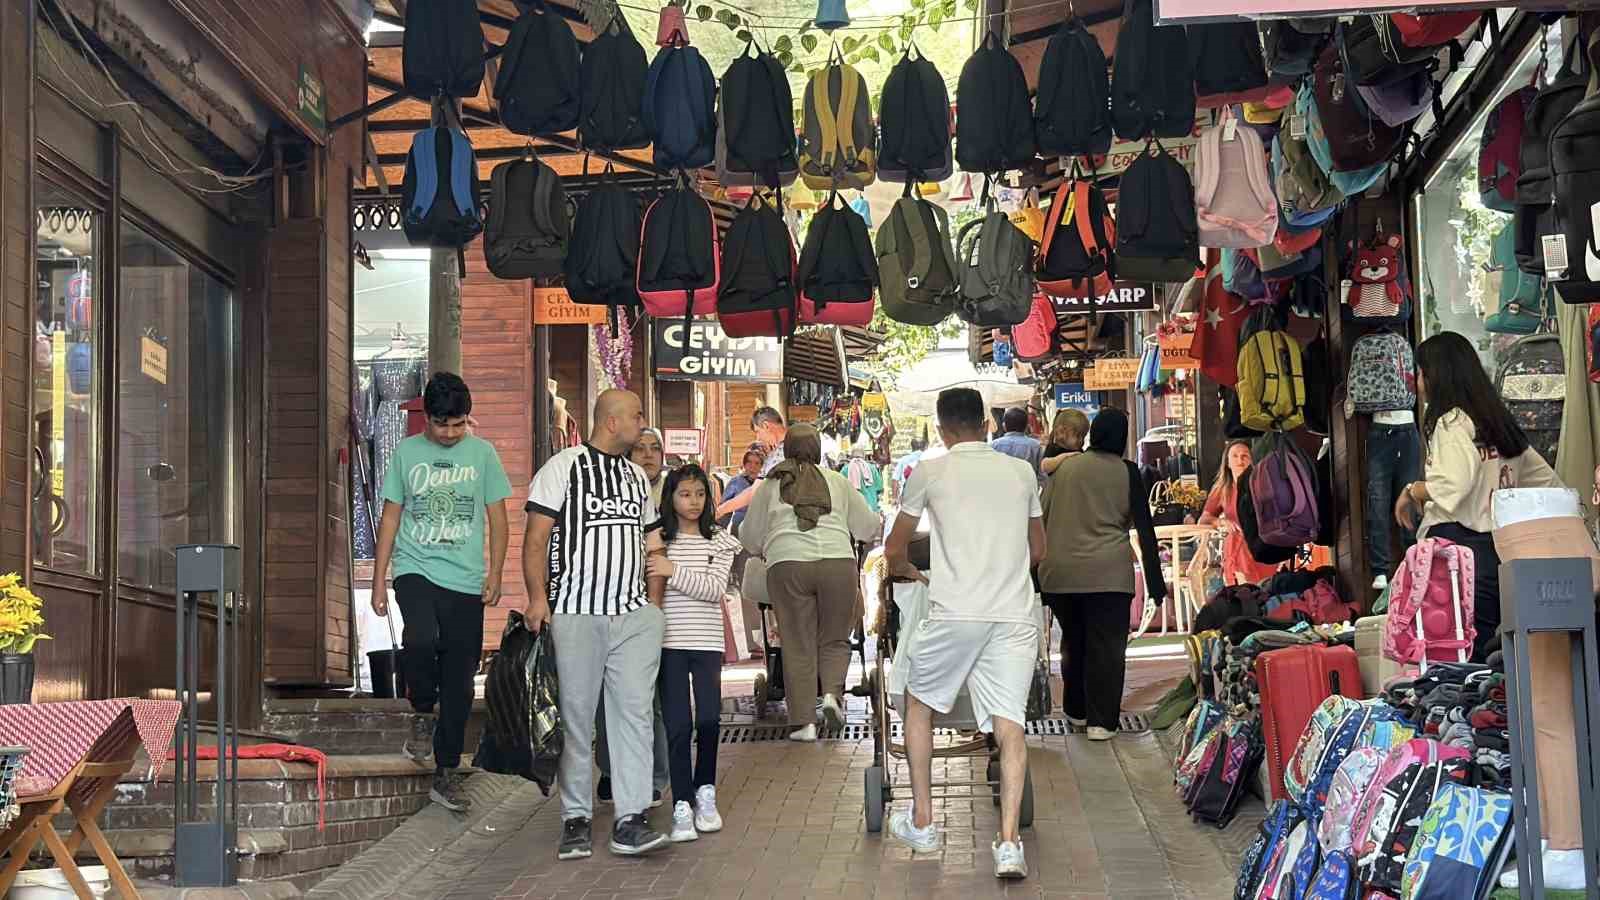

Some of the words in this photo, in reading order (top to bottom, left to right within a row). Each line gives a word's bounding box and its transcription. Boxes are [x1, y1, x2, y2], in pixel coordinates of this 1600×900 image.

[679, 350, 757, 377] GİYİM
[1162, 346, 1188, 358] UĞU
[1061, 391, 1092, 403] Erikli
[408, 462, 479, 497] Denim
[585, 492, 641, 518] beko
[411, 515, 473, 545] Wear
